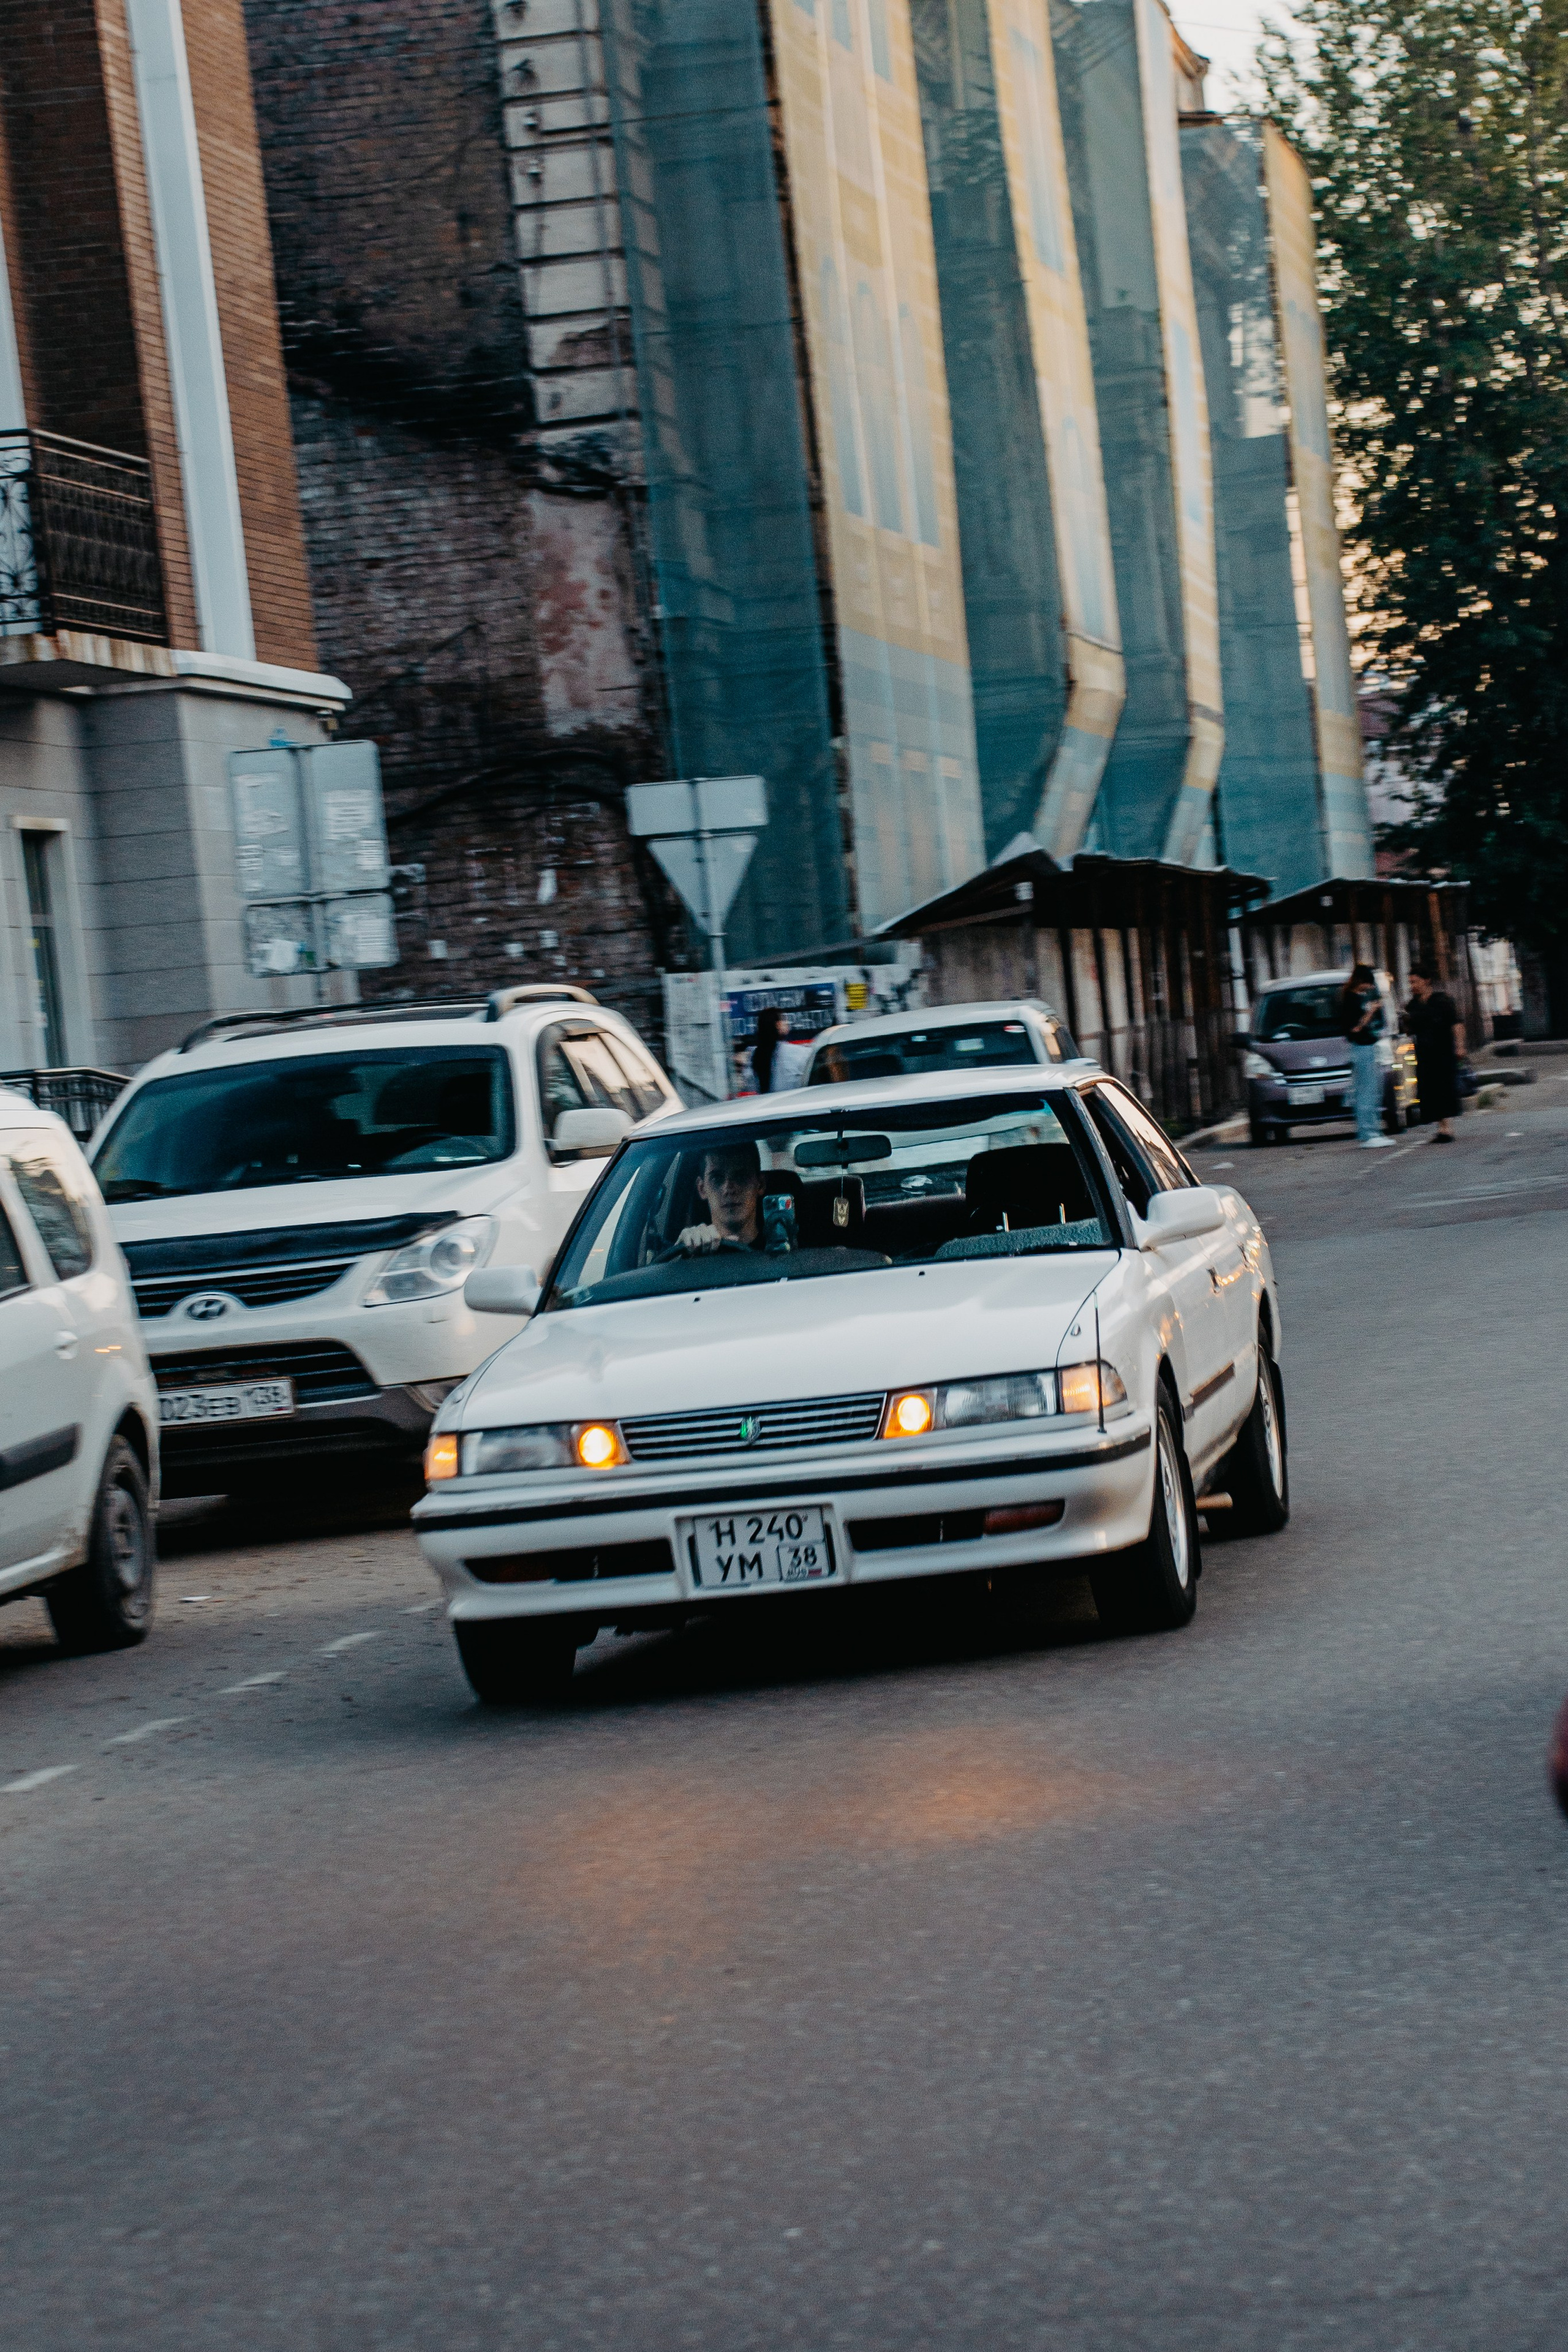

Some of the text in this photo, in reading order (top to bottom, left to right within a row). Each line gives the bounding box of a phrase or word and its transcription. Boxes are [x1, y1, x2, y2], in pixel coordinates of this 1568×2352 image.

[714, 1513, 804, 1548] Н 240
[716, 1545, 818, 1583] УМ 38
